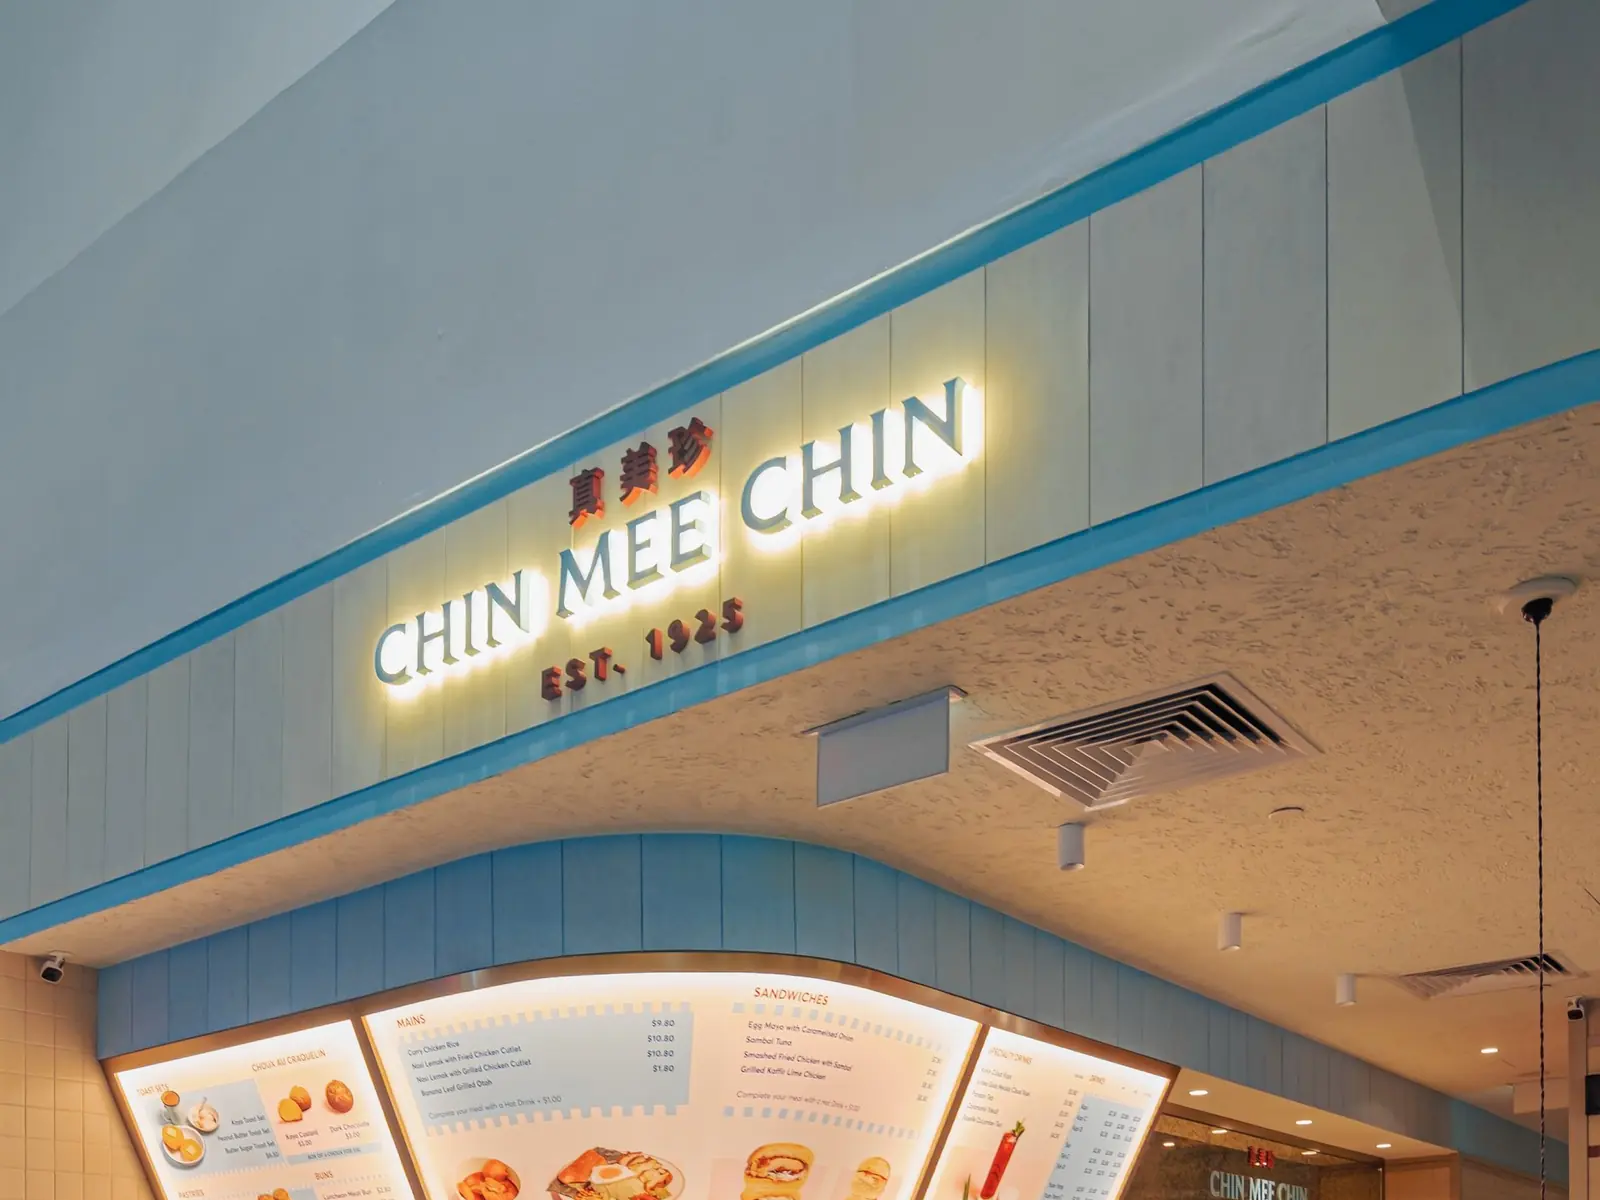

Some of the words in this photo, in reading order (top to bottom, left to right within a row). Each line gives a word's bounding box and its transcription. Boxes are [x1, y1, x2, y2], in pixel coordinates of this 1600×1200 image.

[374, 569, 531, 686] CHIN
[556, 490, 714, 620] MEE
[741, 376, 970, 535] CHIN
[541, 647, 626, 701] EST.
[645, 597, 745, 661] 1925
[754, 987, 829, 1006] SANDWICHES
[396, 1014, 426, 1029] MAINS
[651, 1019, 676, 1028] $9.80
[748, 1020, 763, 1031] Egg
[764, 1022, 785, 1032] Mayo
[786, 1024, 801, 1032] with
[647, 1034, 675, 1043] $10.80
[746, 1035, 775, 1045] Sambal
[776, 1038, 793, 1047] Tuna
[424, 1044, 447, 1054] Chicken
[446, 1040, 461, 1050] Rice
[646, 1050, 675, 1058] $10.80
[411, 1062, 425, 1071] Nasi
[474, 1048, 500, 1059] Chicken
[500, 1044, 523, 1055] Cutlet
[743, 1050, 778, 1060] Smashed
[796, 1055, 821, 1065] Chicken
[416, 1075, 430, 1084] Nasi
[462, 1065, 483, 1076] Grilled
[483, 1061, 510, 1072] Chicken
[510, 1058, 533, 1069] Cutlet
[652, 1064, 675, 1073] $1.80
[740, 1065, 767, 1075] Grilled
[443, 1084, 456, 1094] Leaf
[456, 1080, 477, 1091] Grilled
[1210, 1170, 1246, 1200] CHIN
